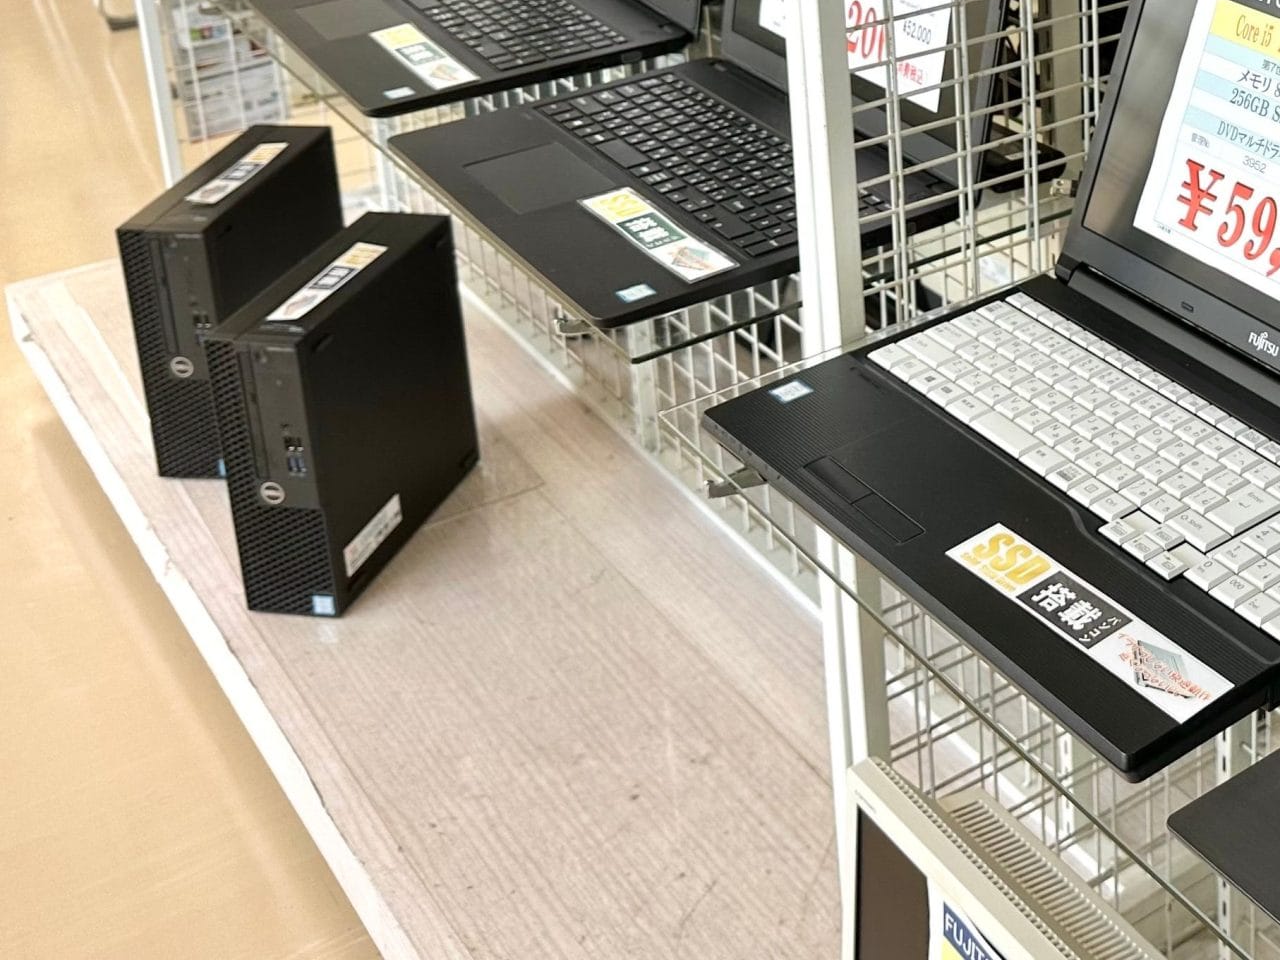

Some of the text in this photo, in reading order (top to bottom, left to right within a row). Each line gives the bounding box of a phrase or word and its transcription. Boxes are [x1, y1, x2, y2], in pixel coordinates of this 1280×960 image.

[1236, 15, 1260, 44] Core
[1261, 24, 1274, 48] i5
[1237, 70, 1272, 93] メモリ
[1230, 88, 1270, 117] 256GB
[1243, 156, 1267, 174] 3952
[1248, 330, 1280, 357] FUJITSU
[971, 533, 1050, 586] SSD
[1031, 582, 1102, 630] 搭載
[1078, 616, 1122, 643] パソコン
